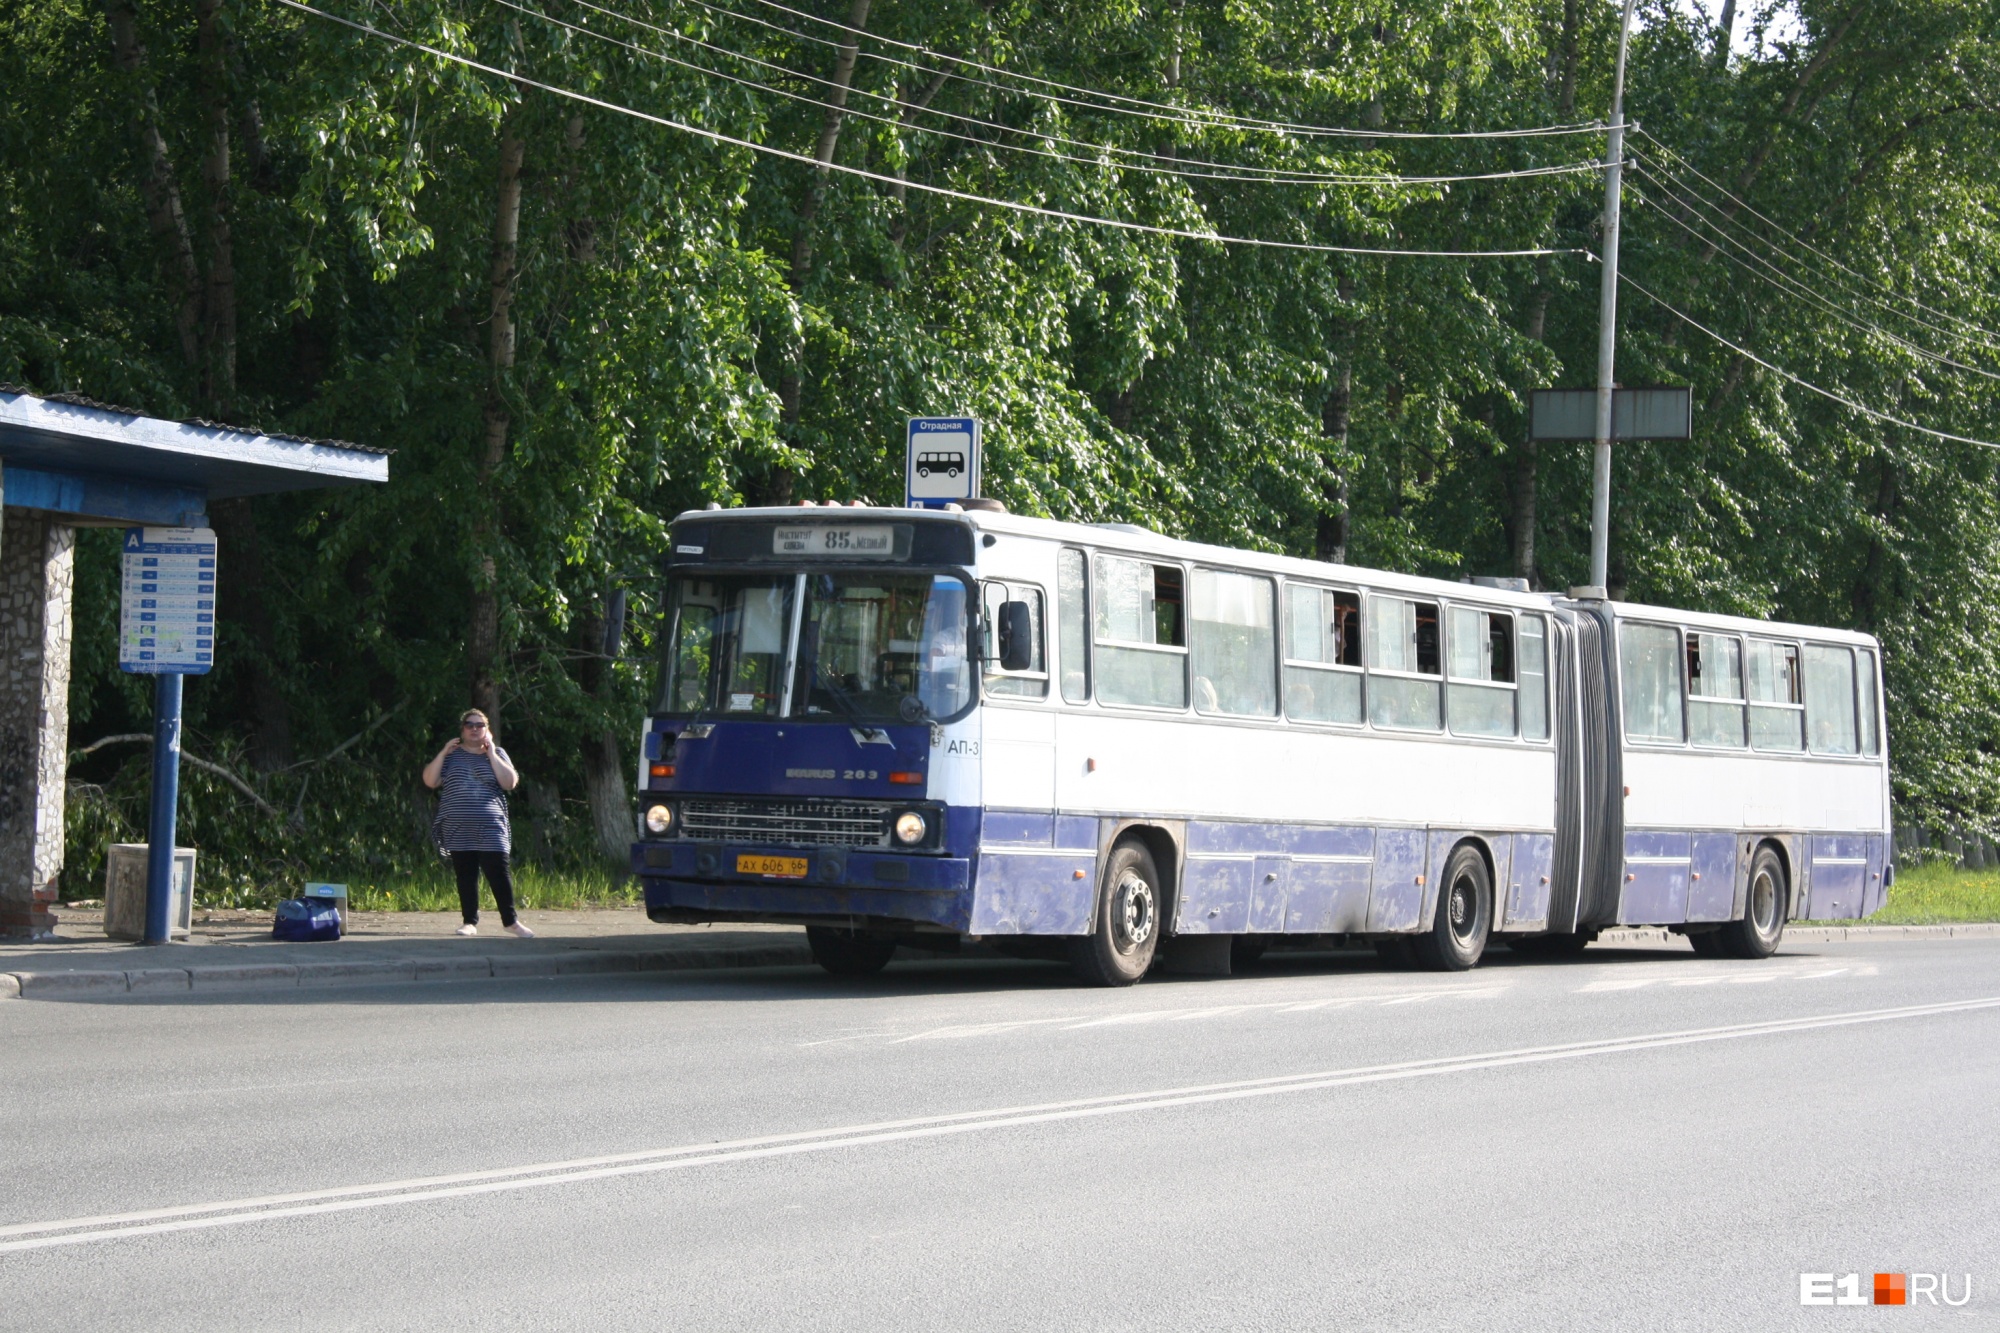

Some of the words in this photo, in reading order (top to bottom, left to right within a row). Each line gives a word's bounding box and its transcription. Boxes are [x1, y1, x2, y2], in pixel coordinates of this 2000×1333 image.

[920, 421, 962, 431] Отрадная
[127, 534, 139, 547] А
[825, 531, 850, 549] 85
[947, 739, 979, 755] АП-3
[762, 858, 784, 872] 606
